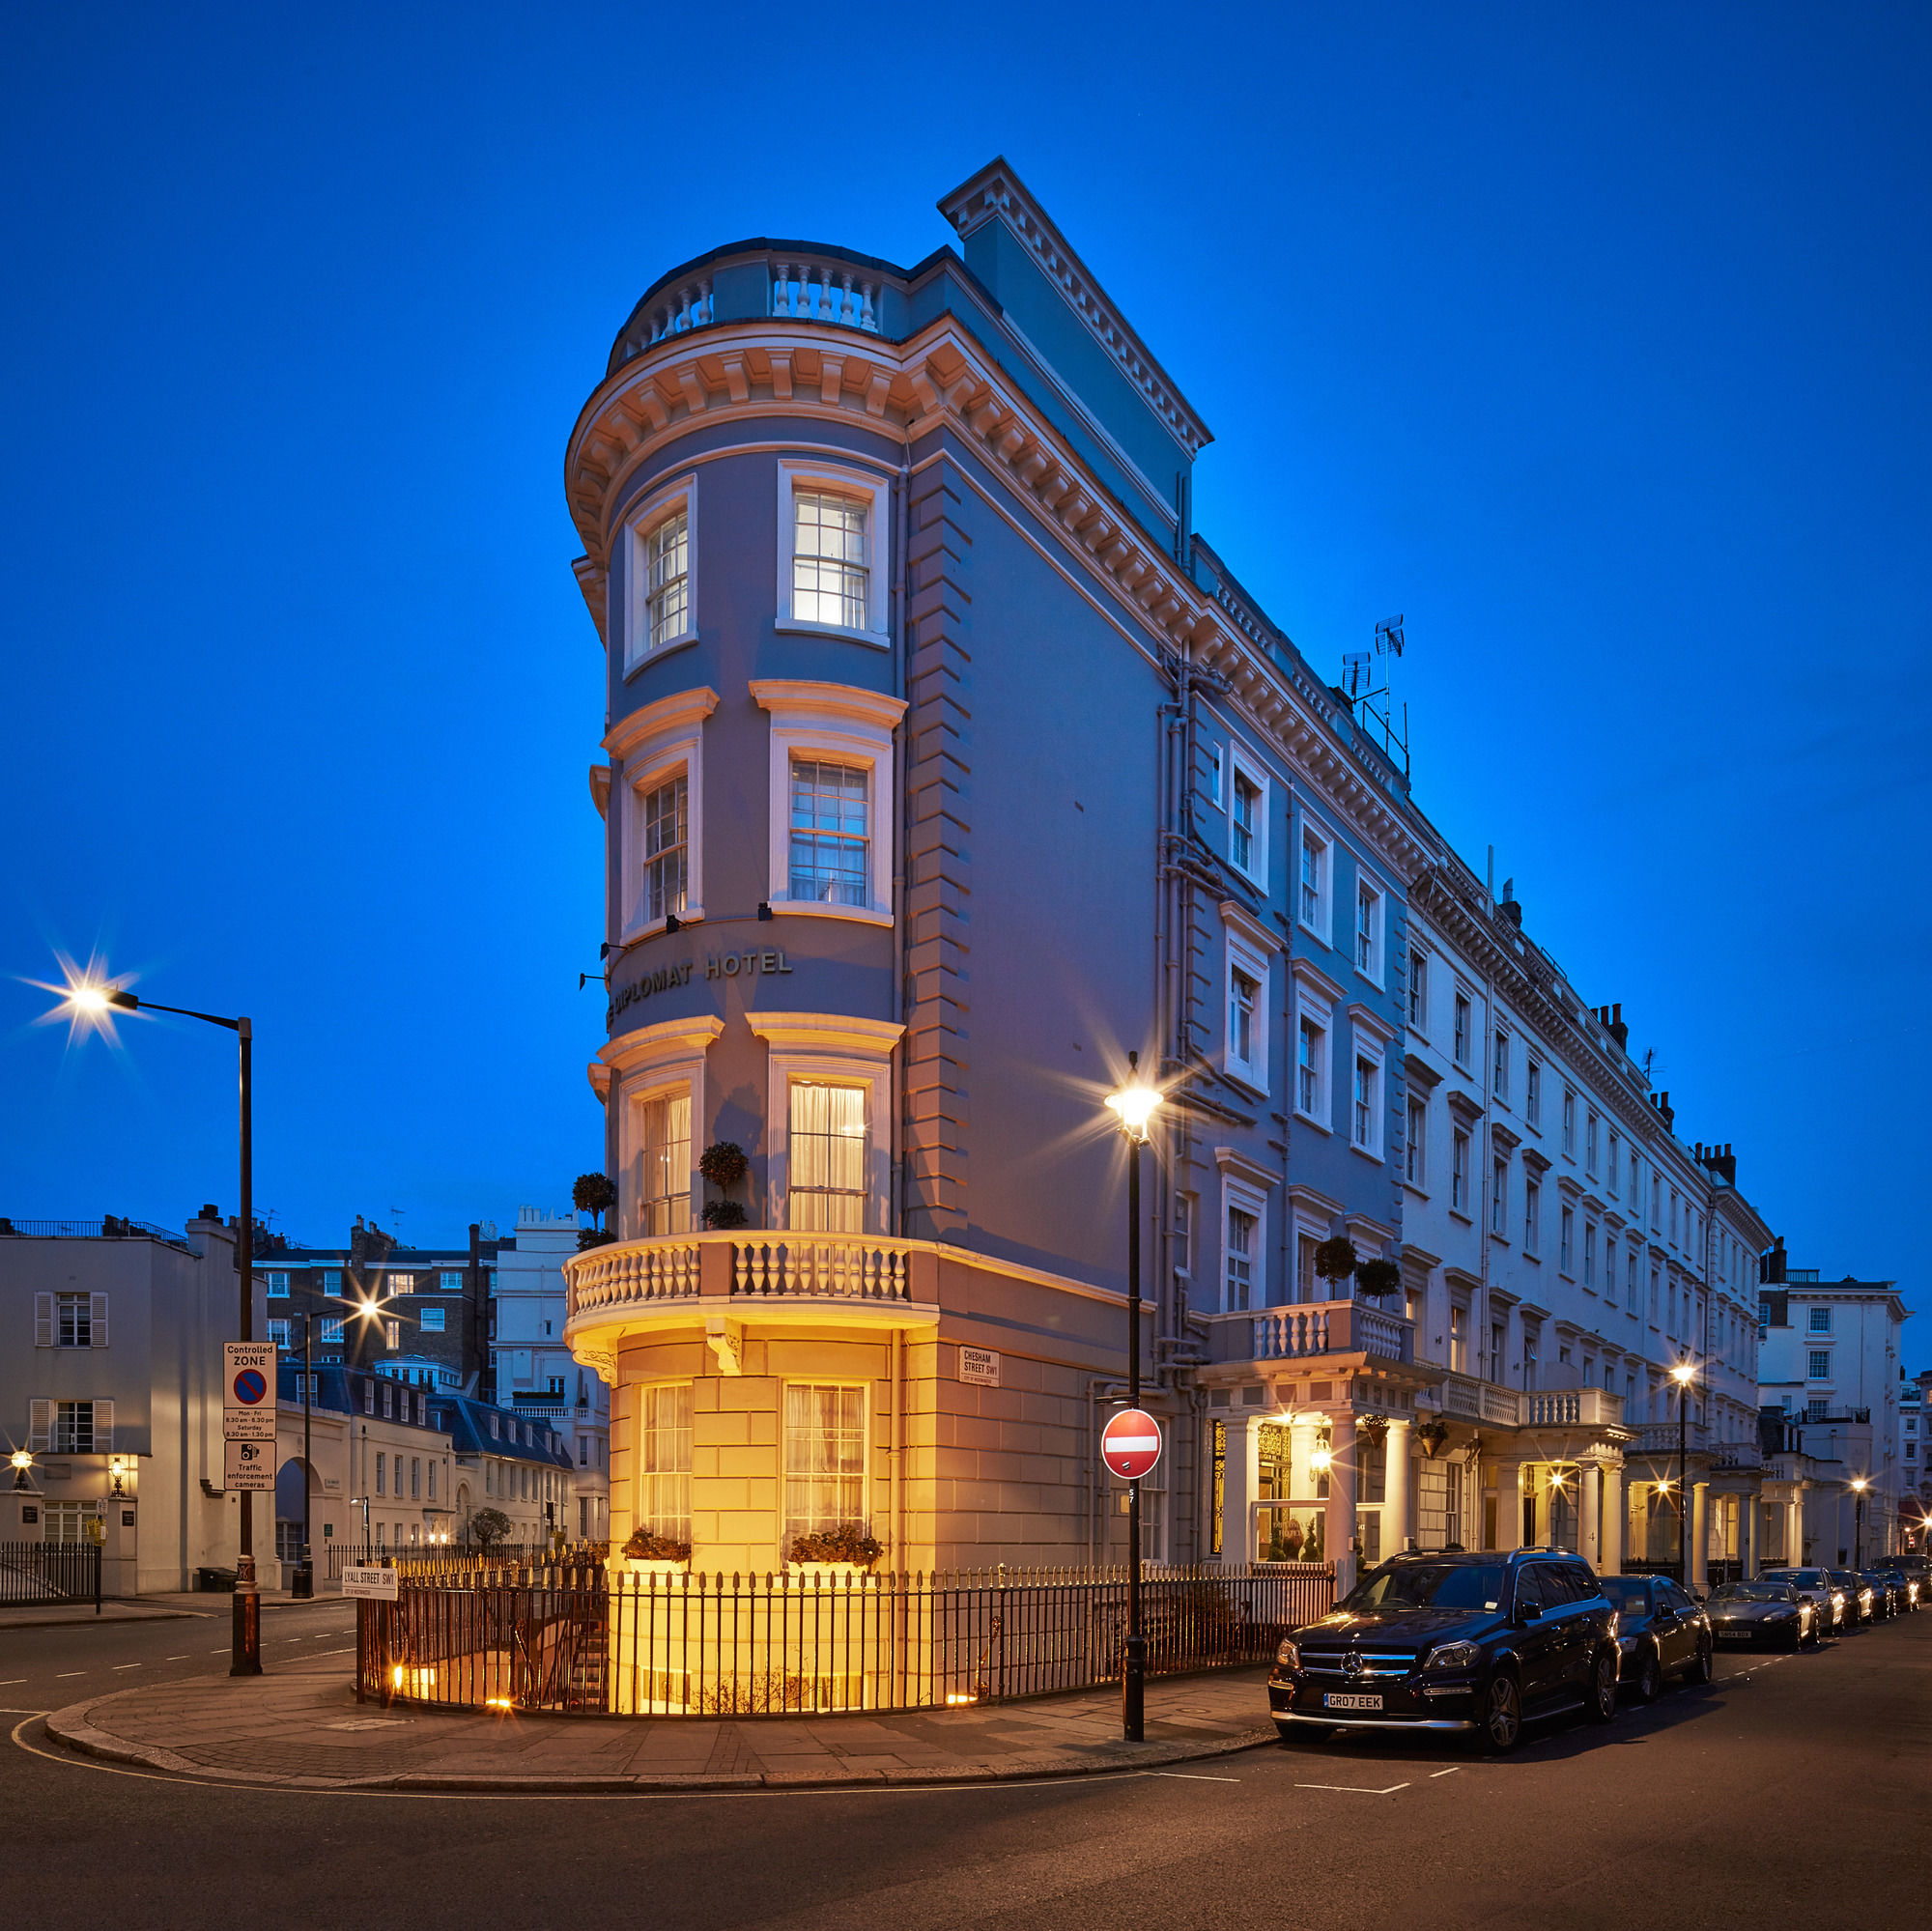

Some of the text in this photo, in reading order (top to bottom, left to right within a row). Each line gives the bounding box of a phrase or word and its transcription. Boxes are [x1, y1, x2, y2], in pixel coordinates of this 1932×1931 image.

[615, 951, 793, 1015] DIPLOMAT HOTEL
[234, 1356, 266, 1365] ZONE
[964, 1350, 991, 1363] CHESHAM
[964, 1362, 997, 1376] STREET SW1
[345, 1571, 394, 1584] LYALL STREET SW1
[1330, 1696, 1380, 1708] GR07 EEK
